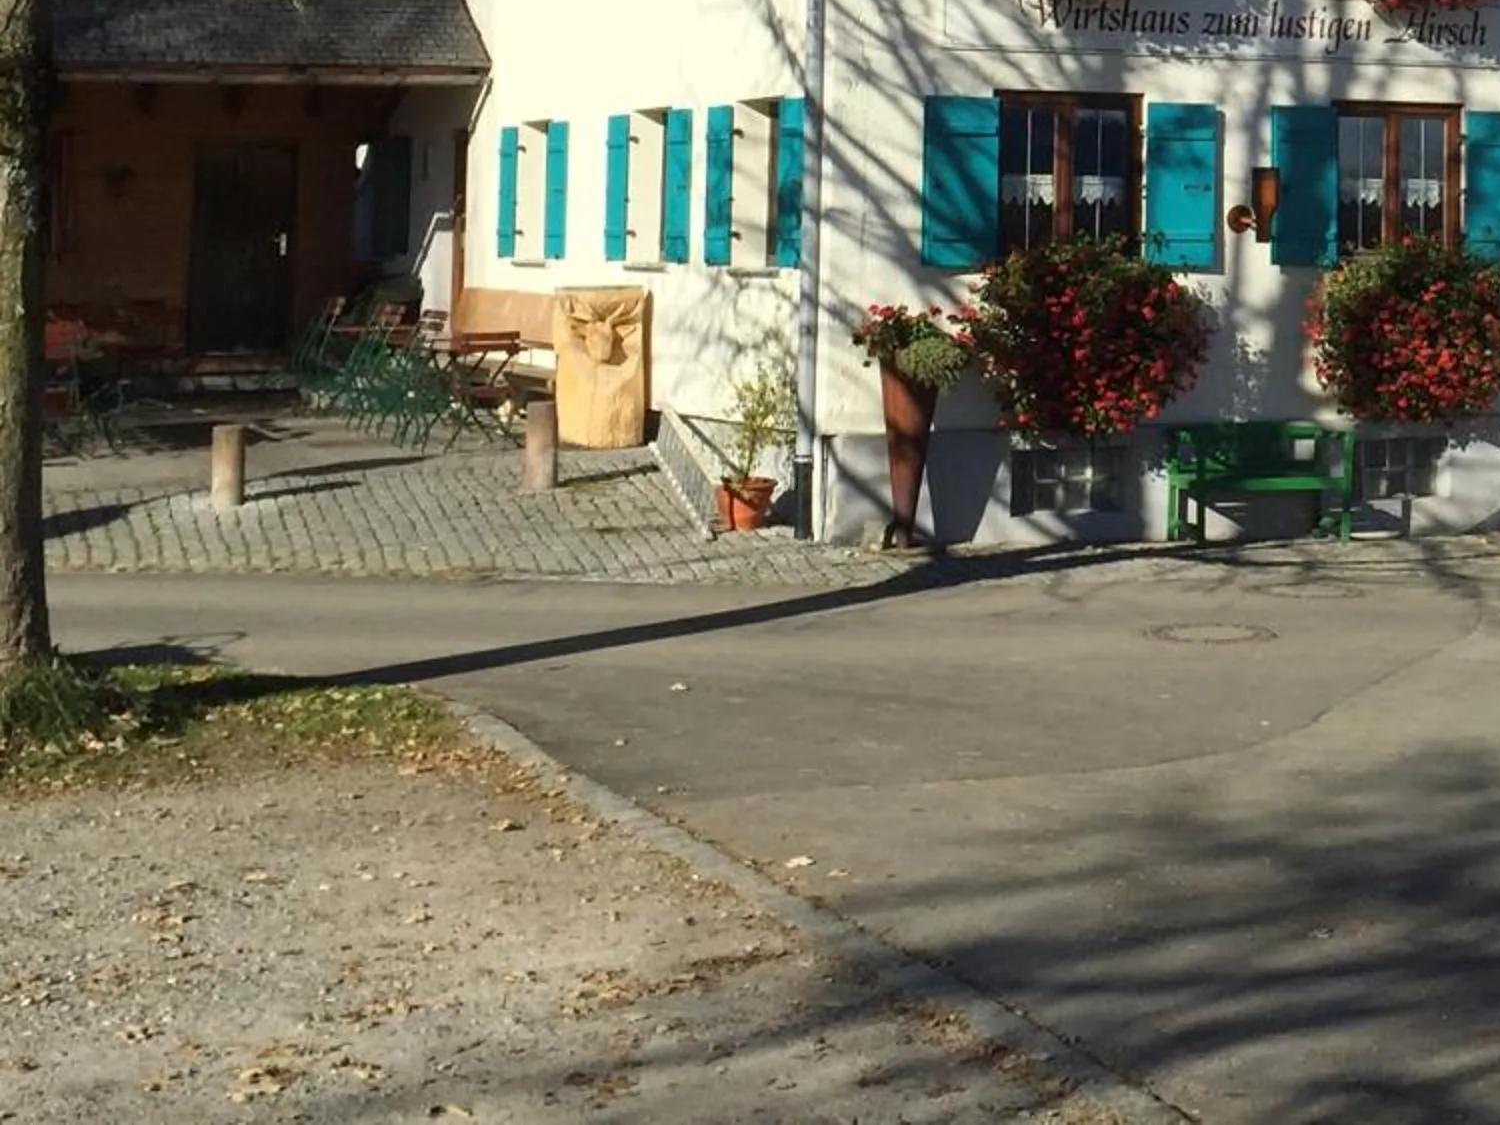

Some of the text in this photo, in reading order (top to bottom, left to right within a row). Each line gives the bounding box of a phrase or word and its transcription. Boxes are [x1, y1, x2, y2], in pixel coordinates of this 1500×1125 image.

[1201, 12, 1260, 37] zum
[1269, 0, 1372, 55] lustigen
[1384, 5, 1487, 47] Hirsch
